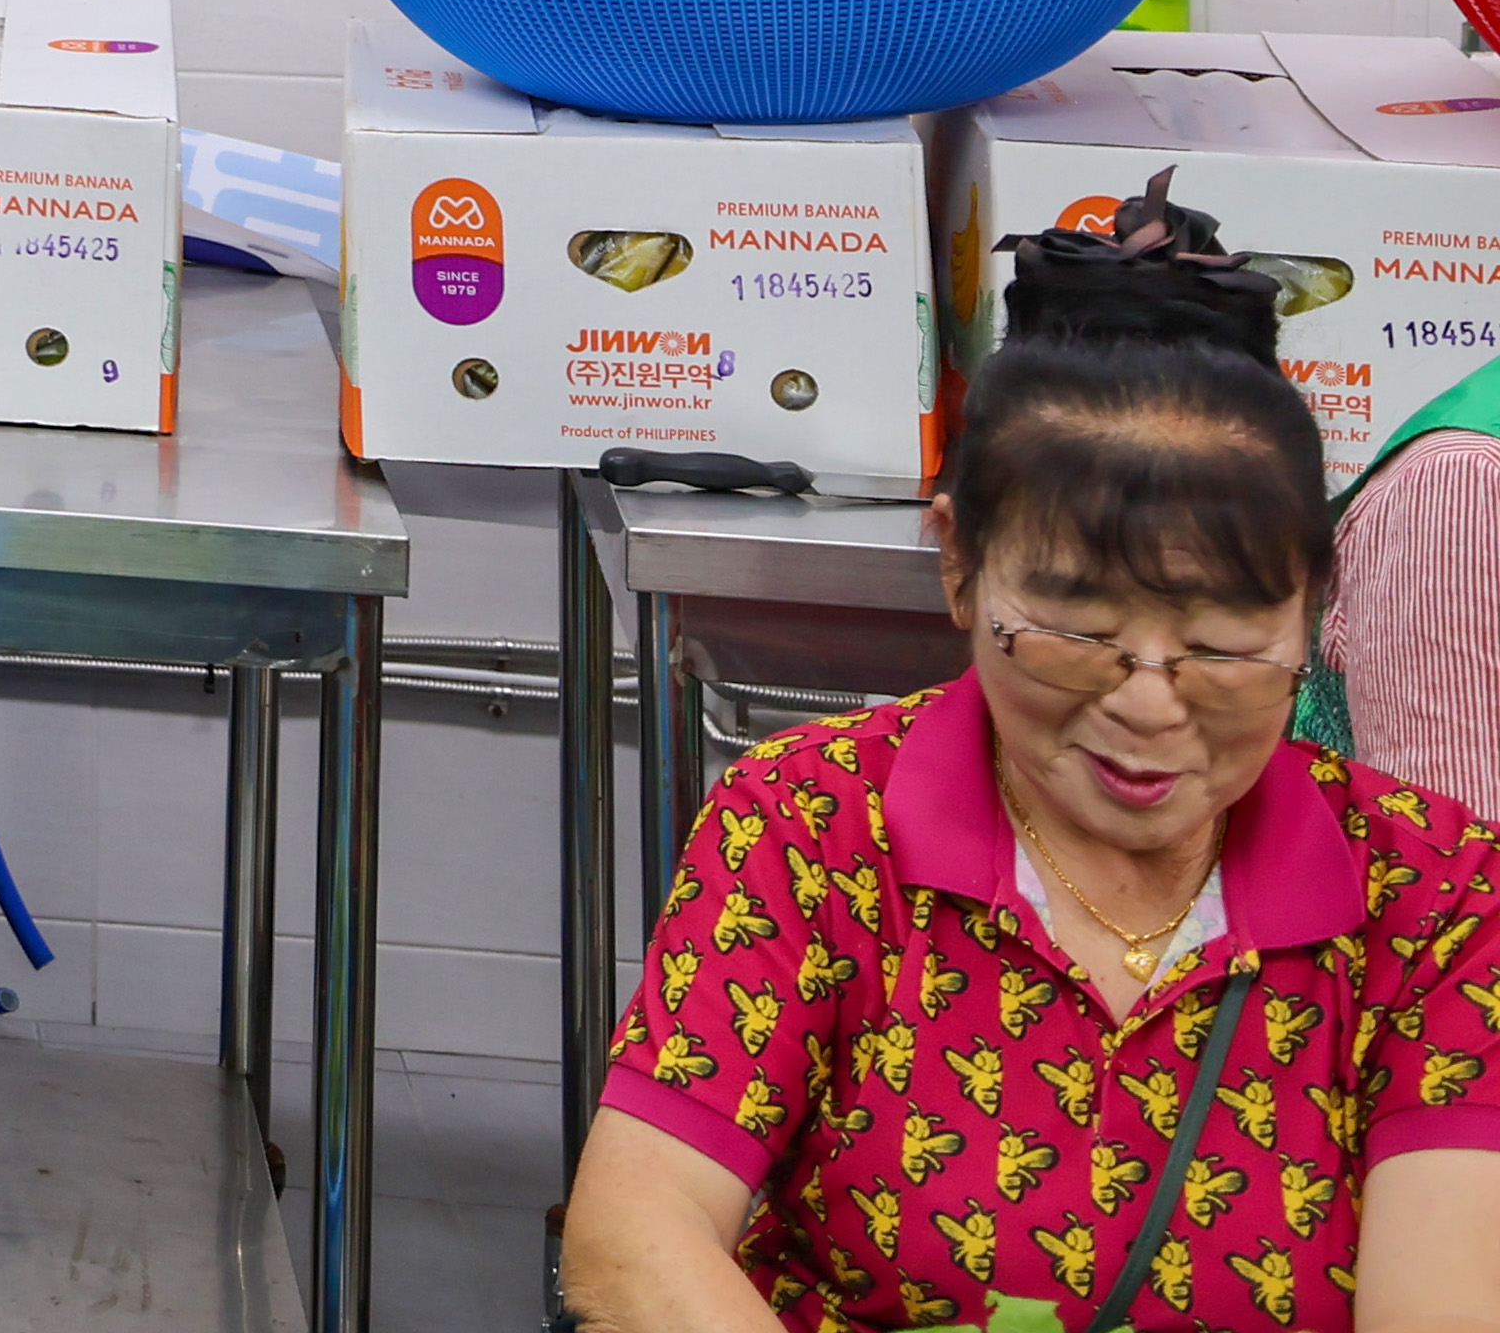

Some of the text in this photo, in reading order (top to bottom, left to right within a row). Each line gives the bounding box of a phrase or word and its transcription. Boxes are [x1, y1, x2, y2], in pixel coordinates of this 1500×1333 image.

[65, 174, 134, 191] BANANA
[717, 202, 880, 219] PREMIUM BANANA
[419, 235, 496, 247] MANNADA
[710, 229, 888, 254] MANNADA
[1383, 230, 1470, 249] PREMIUM
[436, 270, 480, 283] SINCE
[441, 284, 477, 296] 1979
[731, 272, 873, 301] 11845425
[565, 329, 711, 357] JINWON
[1382, 320, 1500, 348] 118454
[102, 359, 120, 383] 9
[717, 349, 736, 377] 8
[566, 359, 713, 390] (주)진원무역
[569, 393, 713, 410] www.jinwon.kr
[561, 425, 717, 442] Product of PHILIPPINES
[1323, 461, 1369, 475] PPINE
